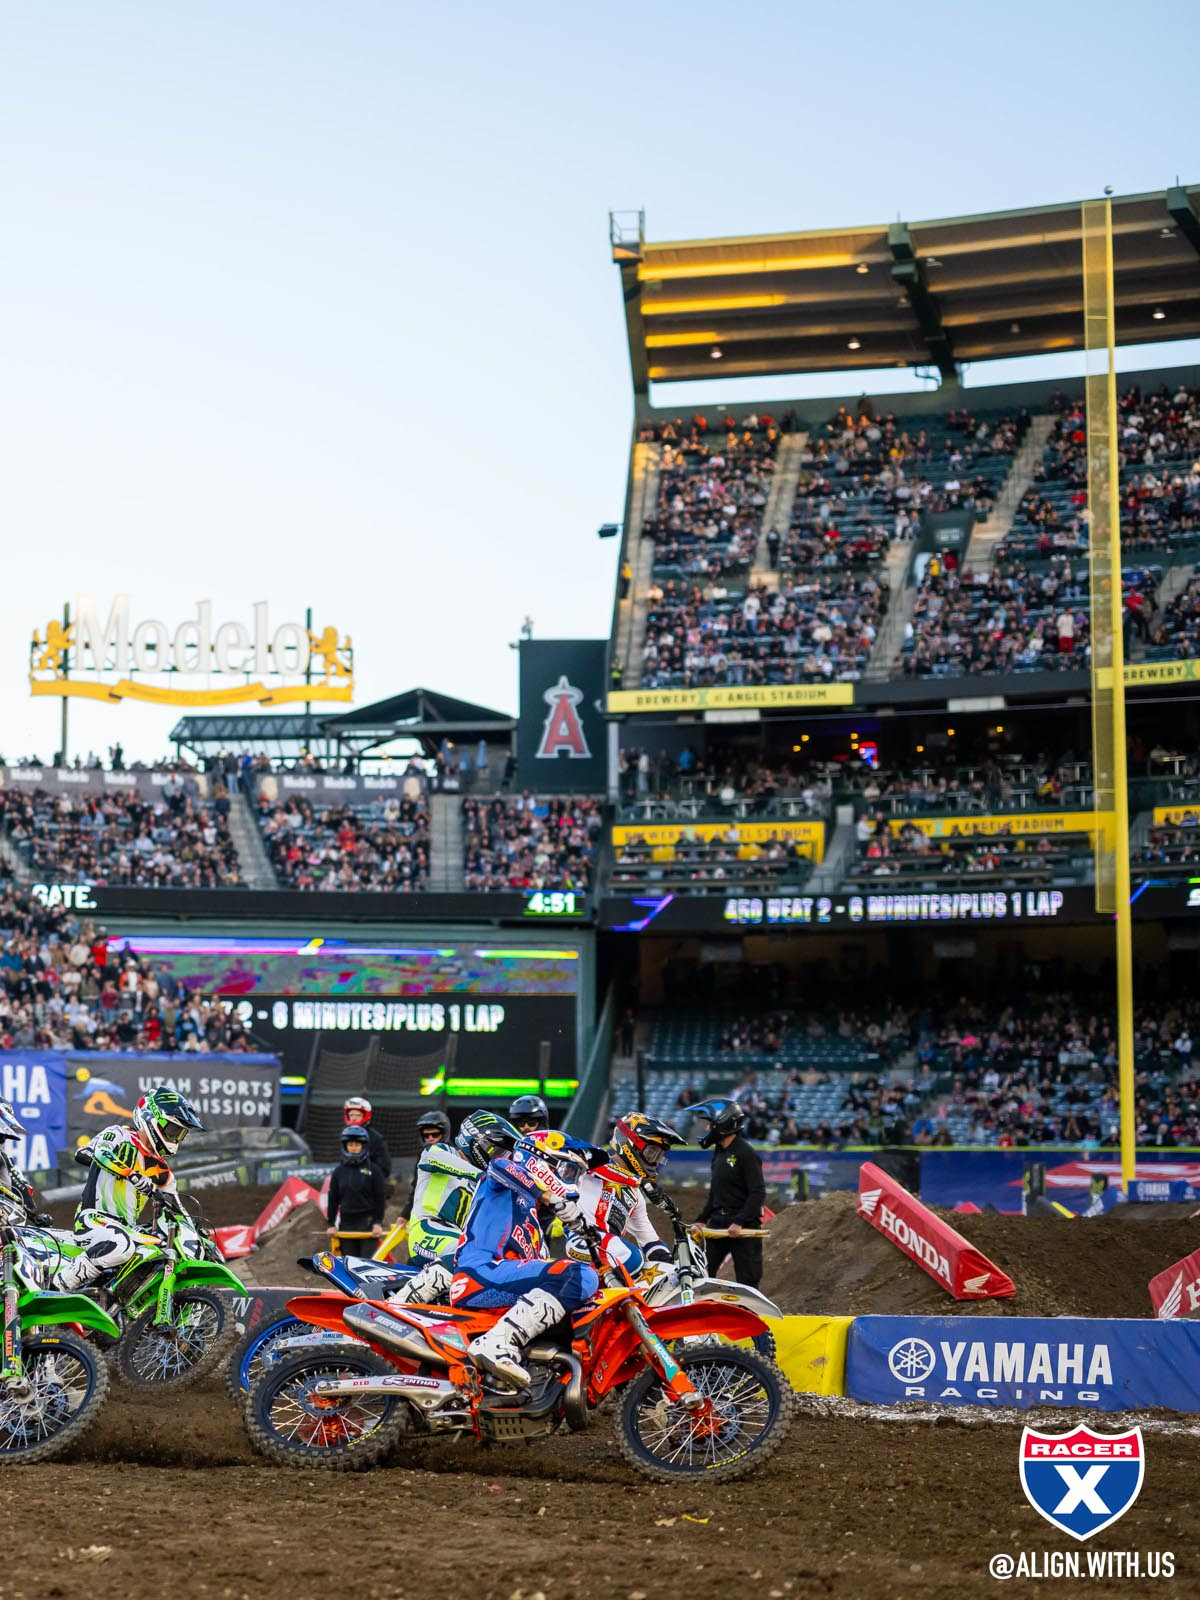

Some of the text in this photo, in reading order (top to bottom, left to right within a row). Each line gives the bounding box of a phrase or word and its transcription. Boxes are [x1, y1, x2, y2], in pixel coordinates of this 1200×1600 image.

[72, 592, 312, 677] Modelo
[1123, 664, 1183, 681] BREWERY
[727, 692, 767, 703] ANGEL
[770, 689, 828, 702] STADIUM
[528, 892, 576, 914] 4:51
[817, 896, 831, 922] 2
[867, 893, 1007, 921] MINUTES/PLUS
[1011, 892, 1022, 917] 1
[1026, 891, 1064, 917] LAP
[292, 1001, 446, 1031] MINUTES/PLUS
[450, 1004, 461, 1032] 1
[464, 1004, 504, 1032] LAP
[138, 1076, 273, 1098] UTAH SPORTS
[419, 1236, 446, 1251] FLY
[879, 1204, 954, 1287] HONDA
[940, 1341, 1114, 1386] YAMAHA
[383, 1376, 440, 1389] RENTHAL
[905, 1387, 1101, 1402] RACING
